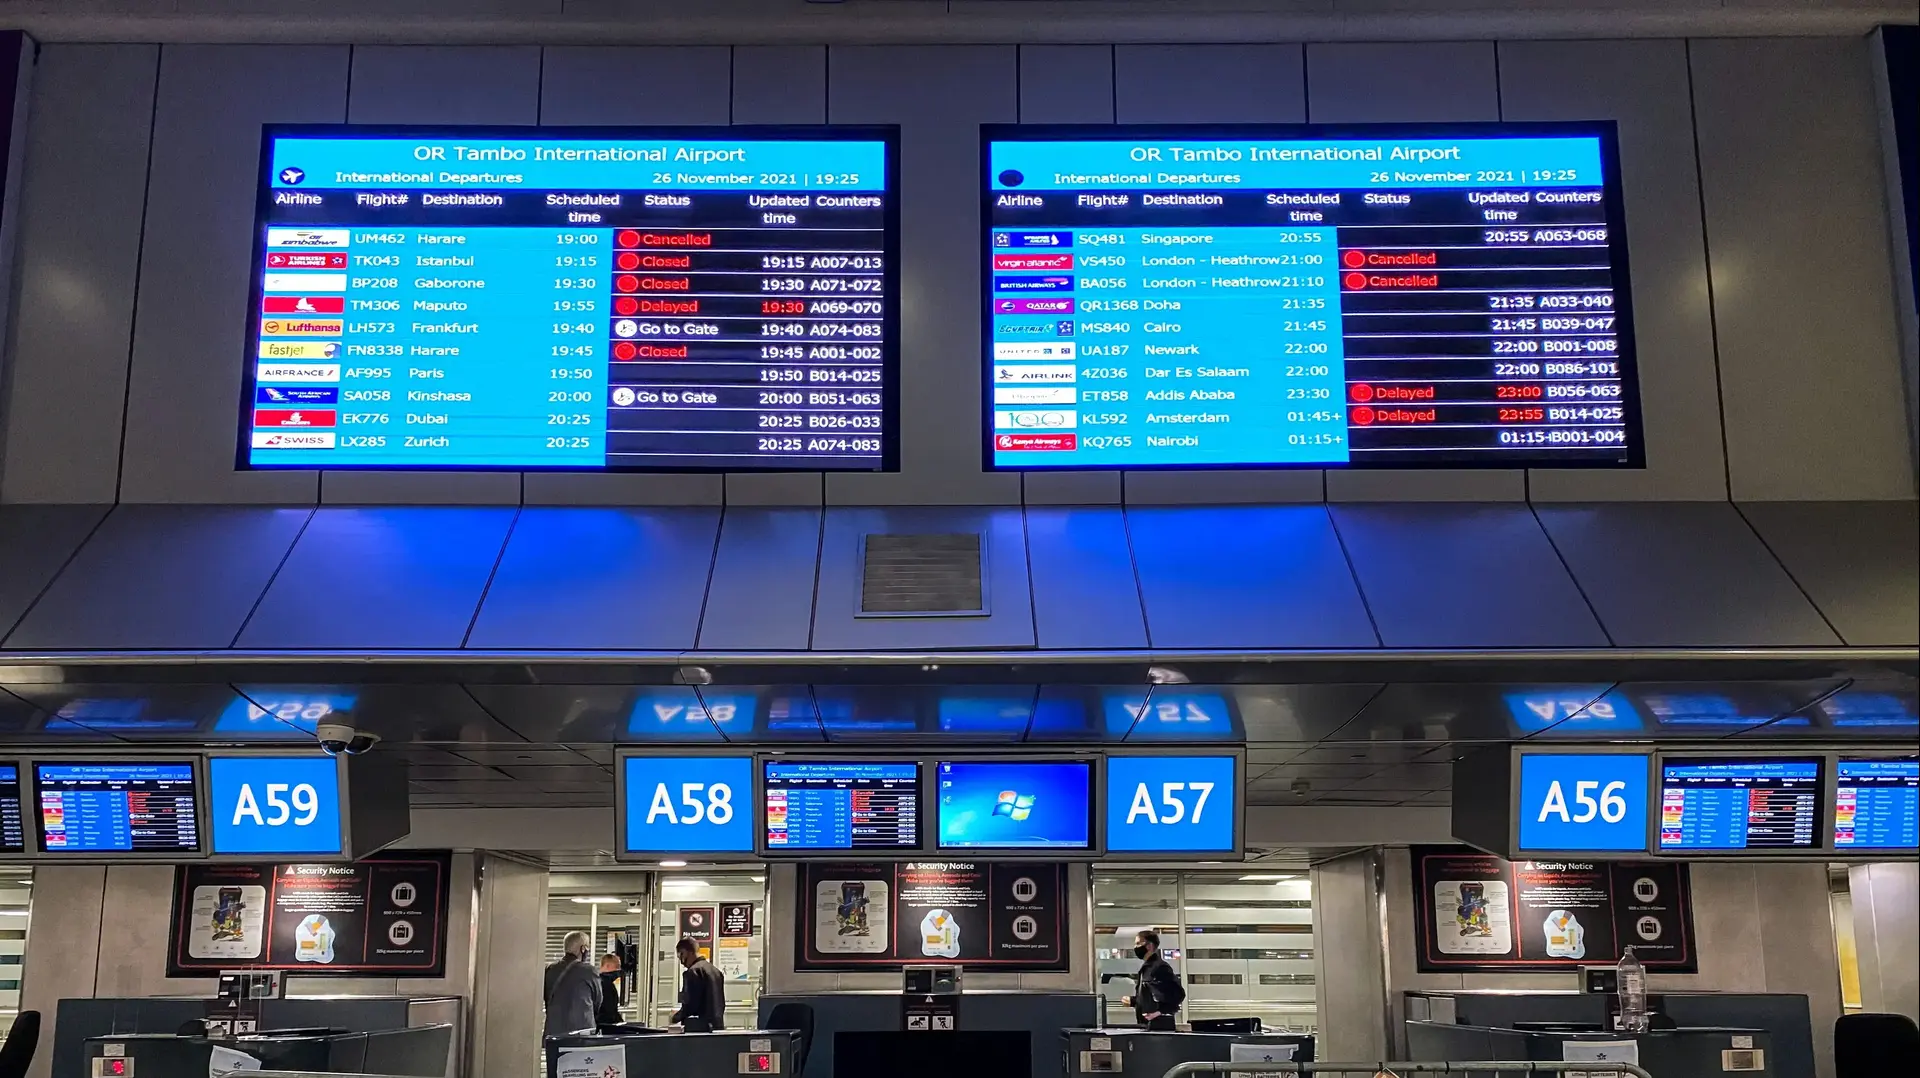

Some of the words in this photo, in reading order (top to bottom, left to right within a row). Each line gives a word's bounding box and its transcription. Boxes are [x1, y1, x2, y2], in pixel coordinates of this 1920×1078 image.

[414, 146, 445, 160] OR
[454, 147, 526, 160] Tambo
[535, 147, 666, 161] International
[675, 148, 745, 164] Airport
[1131, 148, 1161, 161] OR
[1169, 148, 1241, 161] Tambo
[1250, 147, 1381, 161] International
[1390, 147, 1460, 163] Airport
[336, 172, 433, 182] International
[440, 172, 522, 184] Departures
[653, 173, 671, 183] 26
[678, 173, 754, 183] November
[760, 174, 796, 184] 2021
[817, 174, 859, 184] 19:25
[1055, 174, 1151, 184] International
[1158, 173, 1240, 184] Departures
[1371, 172, 1389, 182] 26
[1395, 172, 1471, 182] November
[1477, 171, 1514, 181] 2021
[1534, 170, 1576, 180] 19:25
[276, 193, 322, 204] Airline
[357, 193, 408, 206] Flight#
[423, 194, 502, 205] Destination
[547, 194, 619, 205] Scheduled
[645, 195, 690, 205] Status
[750, 195, 809, 208] Updated
[816, 196, 881, 206] Counters
[998, 195, 1042, 205] Airline
[1078, 195, 1128, 207] Flight#
[1144, 194, 1223, 205] Destination
[1267, 194, 1339, 204] Scheduled
[1364, 193, 1410, 204] Status
[1469, 192, 1529, 205] Updated
[1536, 192, 1601, 202] Counters
[568, 212, 601, 222] time
[763, 213, 796, 223] time
[1290, 211, 1322, 221] time
[1484, 210, 1517, 220] time
[356, 234, 405, 243] UM462
[418, 234, 465, 243] Harare
[557, 235, 597, 244] 19:00
[643, 234, 710, 245] Cancelled
[1080, 234, 1125, 246] SQ481
[1142, 234, 1213, 245] Singapore
[1280, 233, 1321, 242] 20:55
[1486, 231, 1529, 242] 20:55
[1534, 230, 1607, 241] A063-068
[354, 256, 399, 265] TK043
[417, 256, 473, 266] Istanbul
[556, 256, 596, 266] 19:15
[643, 256, 688, 267] Closed
[763, 257, 804, 268] 19:15
[811, 257, 881, 268] A007-013
[1080, 256, 1125, 266] VS450
[1143, 256, 1195, 266] London
[1211, 255, 1280, 265] Heathrow
[1281, 255, 1322, 264] 21:00
[1369, 254, 1435, 265] Cancelled
[352, 278, 398, 288] BP208
[415, 278, 485, 288] Gaborone
[555, 279, 595, 288] 19:30
[642, 279, 688, 290] Closed
[763, 279, 804, 290] 19:30
[811, 280, 881, 291] A071-072
[1081, 278, 1126, 288] BA056
[1143, 278, 1196, 288] London
[1212, 277, 1281, 287] Heathrow
[1283, 277, 1324, 287] 21:10
[1370, 276, 1437, 287] Cancelled
[351, 300, 400, 310] TM306
[414, 301, 467, 312] Maputo
[554, 301, 594, 310] 19:55
[642, 301, 697, 314] Delayed
[763, 302, 804, 313] 19:30
[810, 302, 881, 313] A069-070
[1080, 300, 1138, 312] QR1368
[1144, 300, 1180, 310] Doha
[1283, 299, 1324, 308] 21:35
[1491, 297, 1534, 308] 21:35
[1540, 296, 1613, 307] A033-040
[287, 323, 340, 331] Lufthansa
[349, 323, 394, 333] LH573
[413, 323, 478, 332] Frankfurt
[553, 323, 594, 333] 19:40
[639, 323, 660, 334] Go
[664, 324, 680, 334] to
[683, 323, 718, 335] Gate
[762, 324, 803, 335] 19:40
[810, 324, 881, 336] A074-083
[270, 344, 304, 357] fastjet
[348, 345, 403, 355] FN8338
[411, 346, 459, 355] Harare
[552, 346, 592, 356] 19:45
[639, 346, 687, 357] Closed
[762, 347, 803, 358] 19:45
[810, 347, 880, 359] A001-002
[344, 391, 390, 400] SA058
[408, 391, 471, 401] Kinshasa
[549, 392, 591, 402] 20:00
[637, 392, 658, 402] Go
[662, 392, 678, 402] to
[682, 392, 717, 403] Gate
[760, 393, 802, 404] 20:00
[810, 393, 880, 404] B051-063
[1083, 391, 1128, 401] ET858
[1146, 390, 1185, 400] Addis
[1190, 390, 1235, 400] Ababa
[1287, 389, 1329, 399] 23:30
[1377, 387, 1433, 401] Delayed
[1498, 387, 1542, 397] 23:00
[1548, 385, 1621, 397] B056-063
[341, 436, 386, 446] LX285
[405, 437, 449, 446] Zurich
[547, 438, 589, 447] 20:25
[759, 439, 801, 450] 20:25
[808, 439, 880, 450] A074-083
[1083, 437, 1131, 448] KQ765
[1147, 436, 1198, 446] Nairobi
[1289, 434, 1342, 444] 01:15+
[1552, 431, 1624, 442] B001-004
[232, 783, 318, 825] A59
[646, 783, 733, 824] A58
[1127, 782, 1214, 824] A57
[1538, 780, 1626, 823] A56
[297, 866, 327, 875] Security
[918, 863, 948, 871] Security
[1536, 863, 1567, 871] Security
